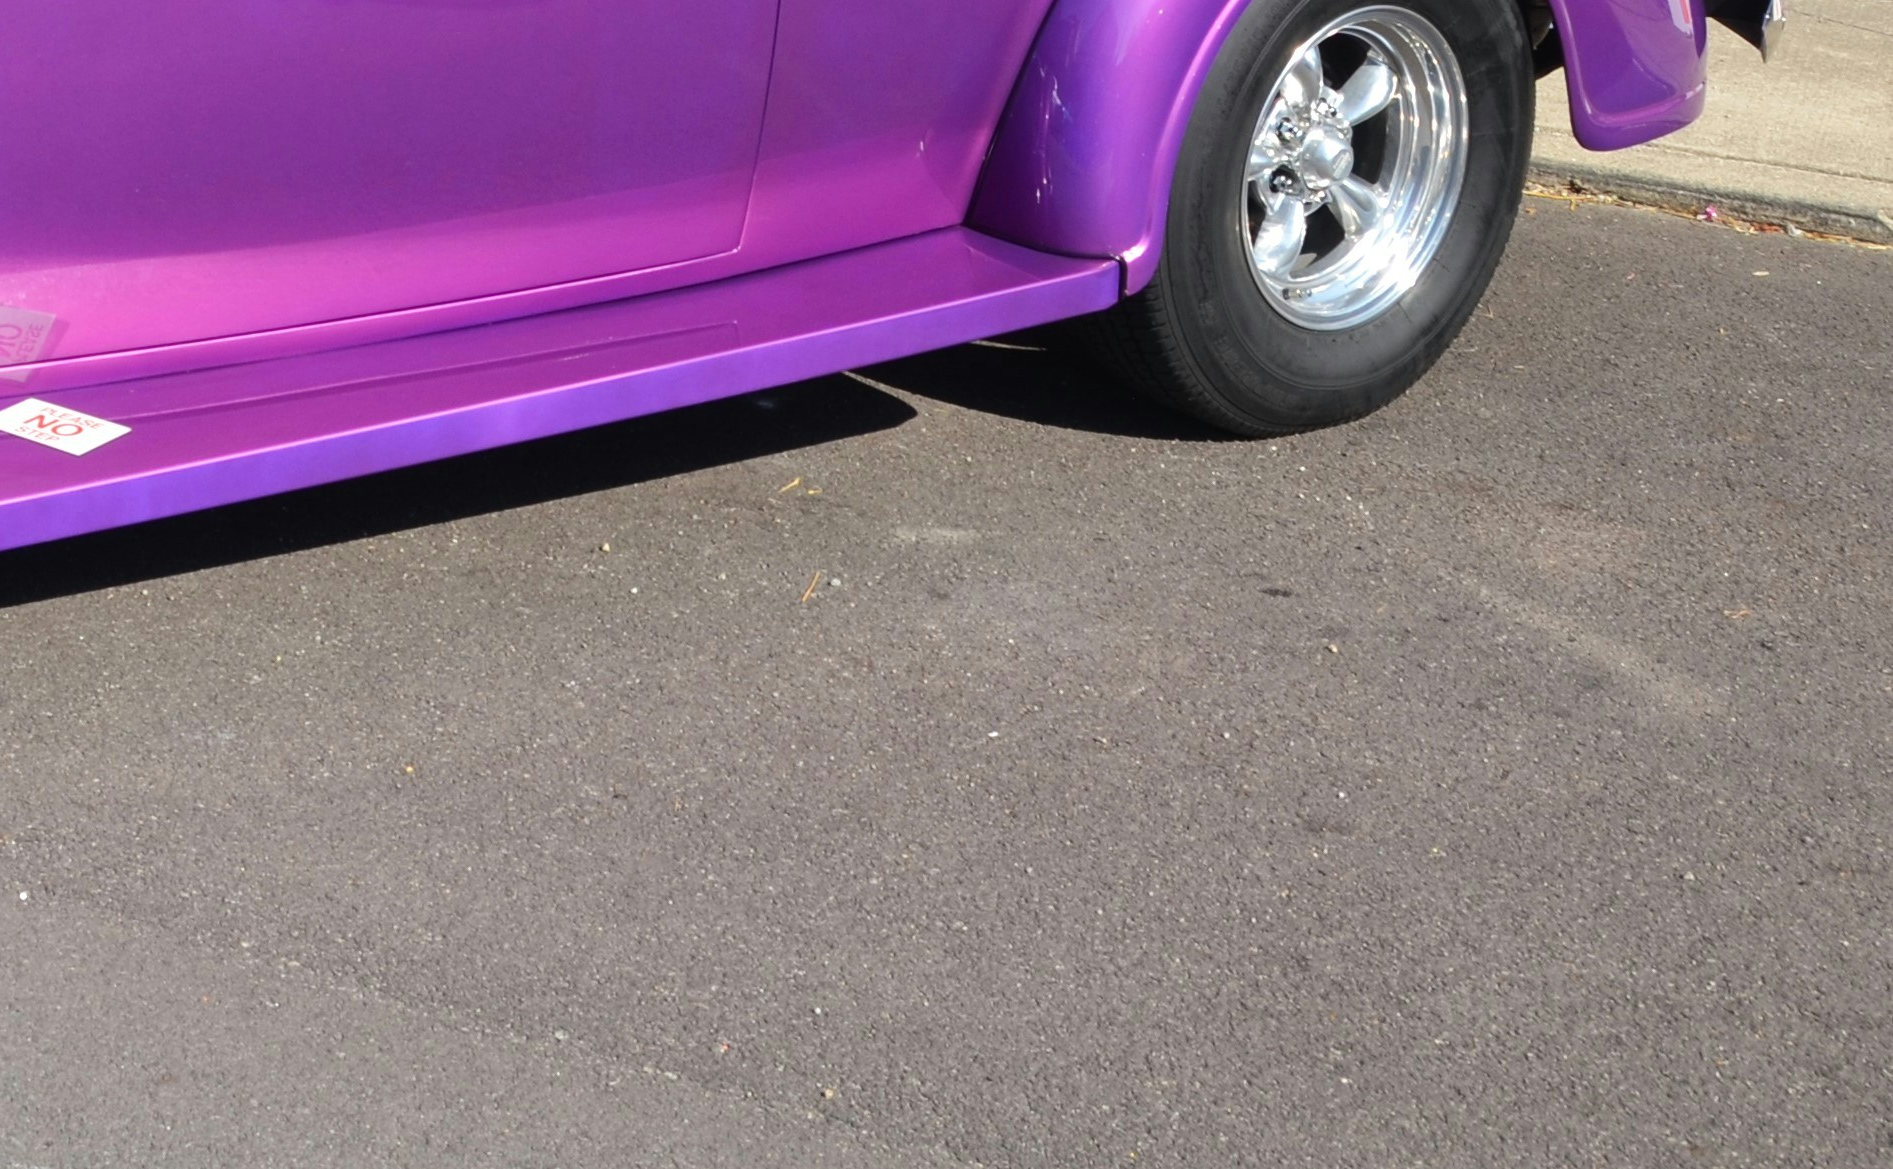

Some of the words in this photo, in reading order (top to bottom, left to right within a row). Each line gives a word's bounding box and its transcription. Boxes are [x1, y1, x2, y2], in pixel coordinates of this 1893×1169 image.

[23, 414, 84, 437] NO
[41, 406, 106, 430] PLEASE
[15, 426, 60, 442] STEP
